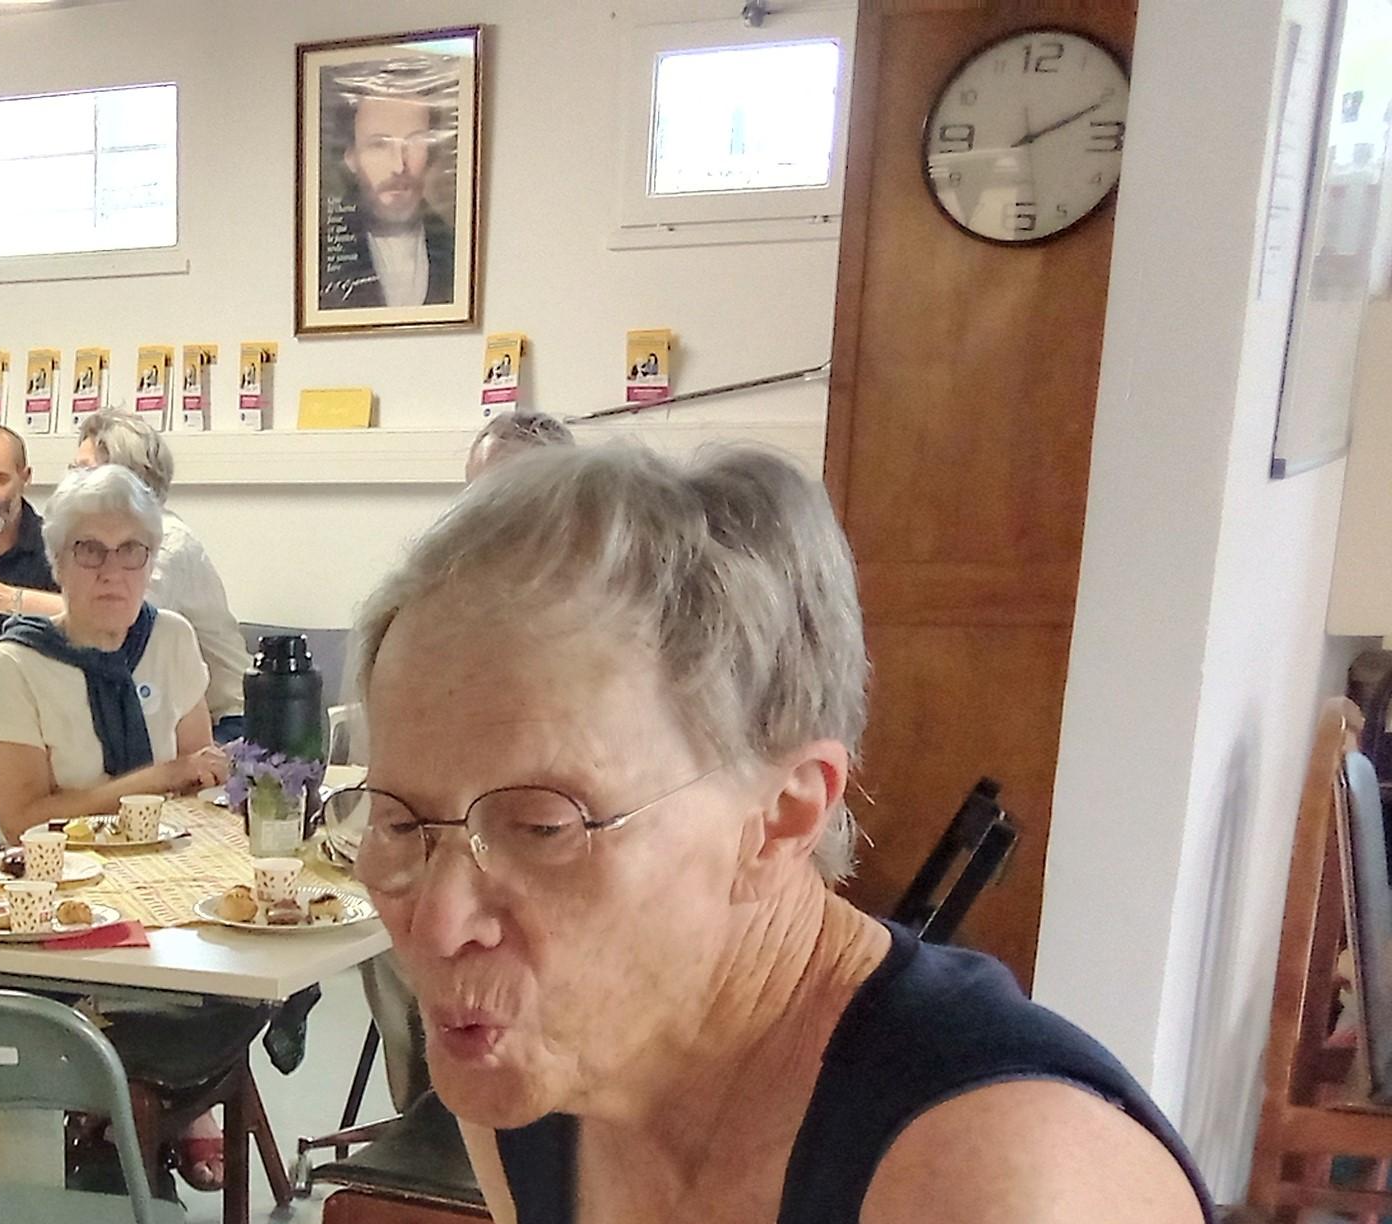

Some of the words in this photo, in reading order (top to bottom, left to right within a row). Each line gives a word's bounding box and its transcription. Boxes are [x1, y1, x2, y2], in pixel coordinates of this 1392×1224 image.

[1022, 42, 1065, 74] 12
[960, 89, 978, 107] 10
[939, 123, 975, 154] 9
[1085, 120, 1126, 152] 3
[1003, 202, 1037, 232] 6
[1056, 203, 1068, 217] 5
